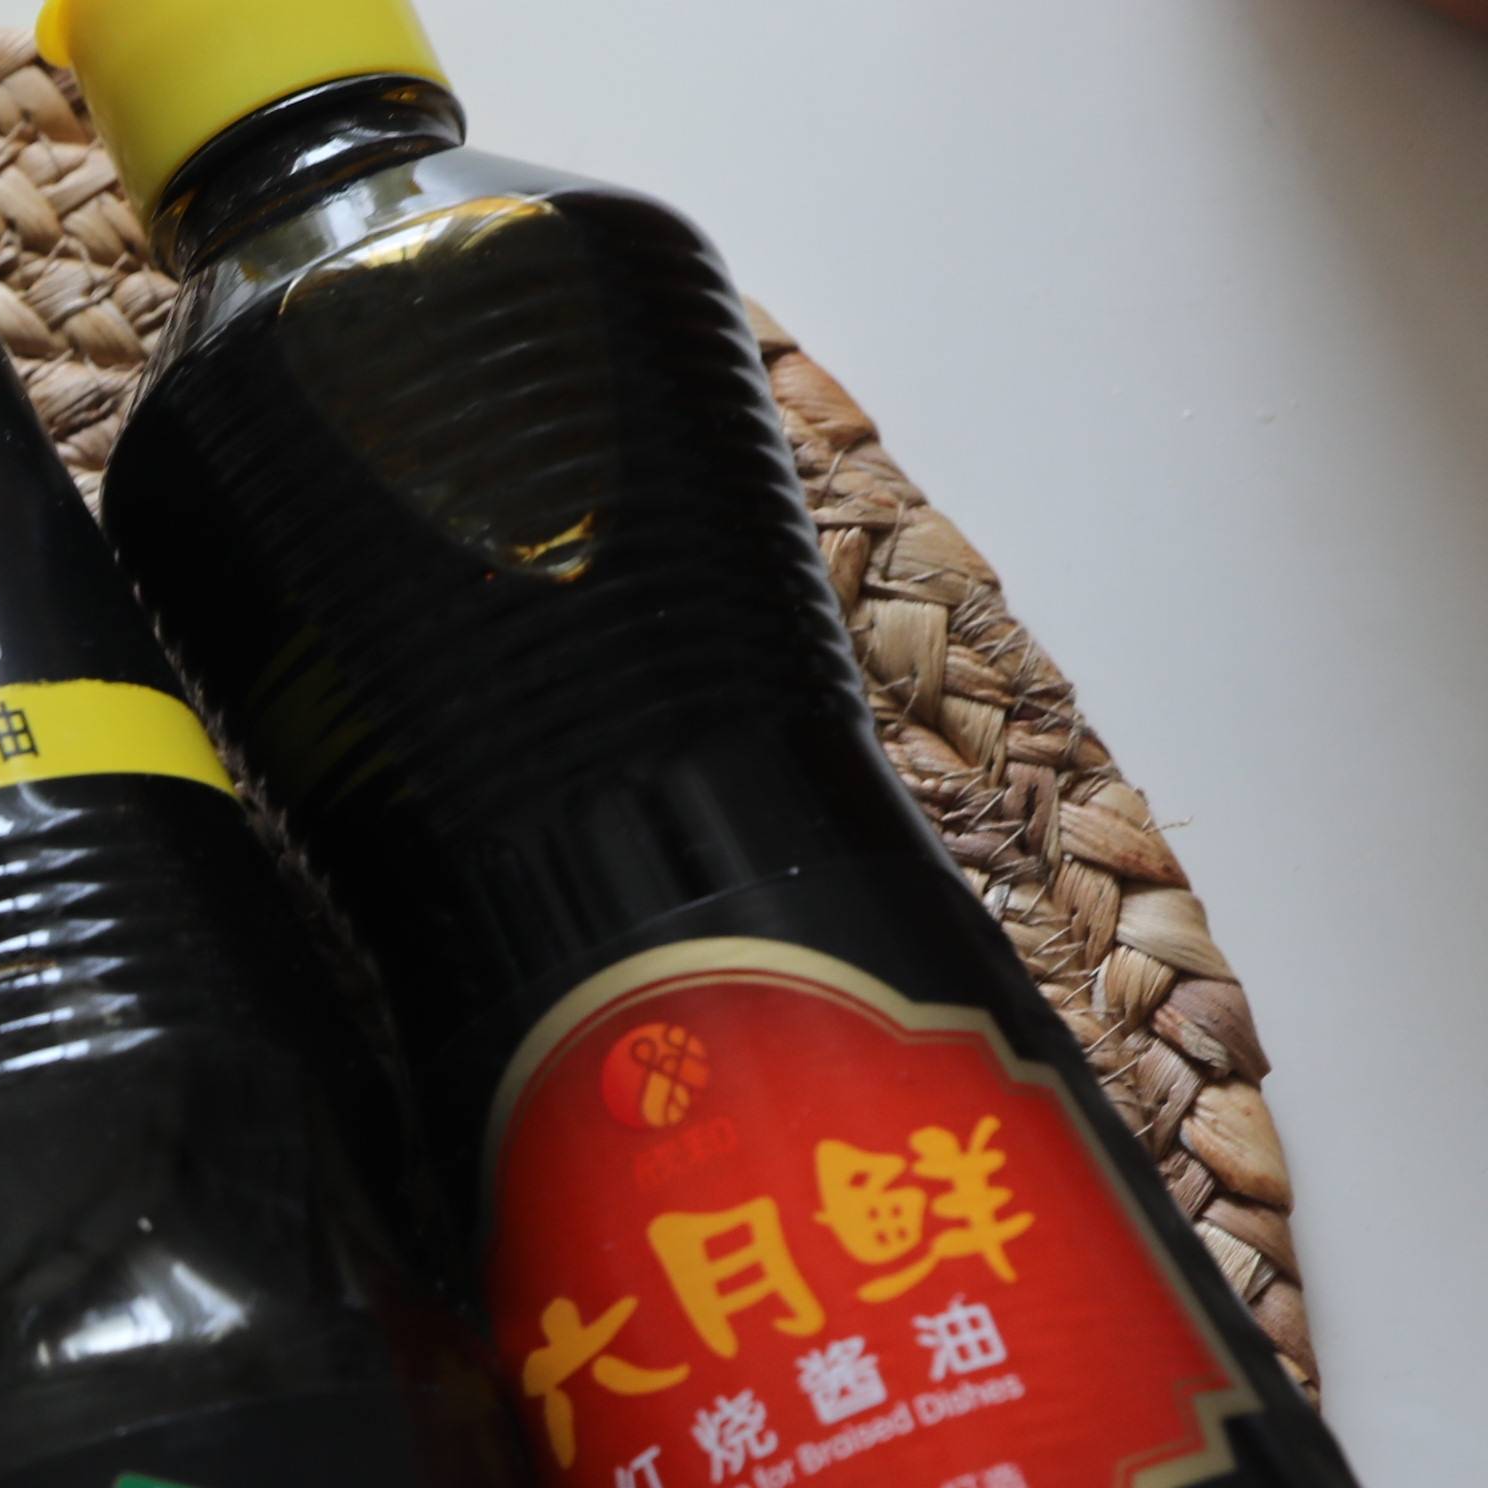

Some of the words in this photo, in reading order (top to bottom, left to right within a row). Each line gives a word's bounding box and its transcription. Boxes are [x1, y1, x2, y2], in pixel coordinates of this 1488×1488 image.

[521, 1115, 1036, 1470] 六月鲜
[795, 1401, 916, 1477] Braised
[912, 1372, 1026, 1427] Dishes
